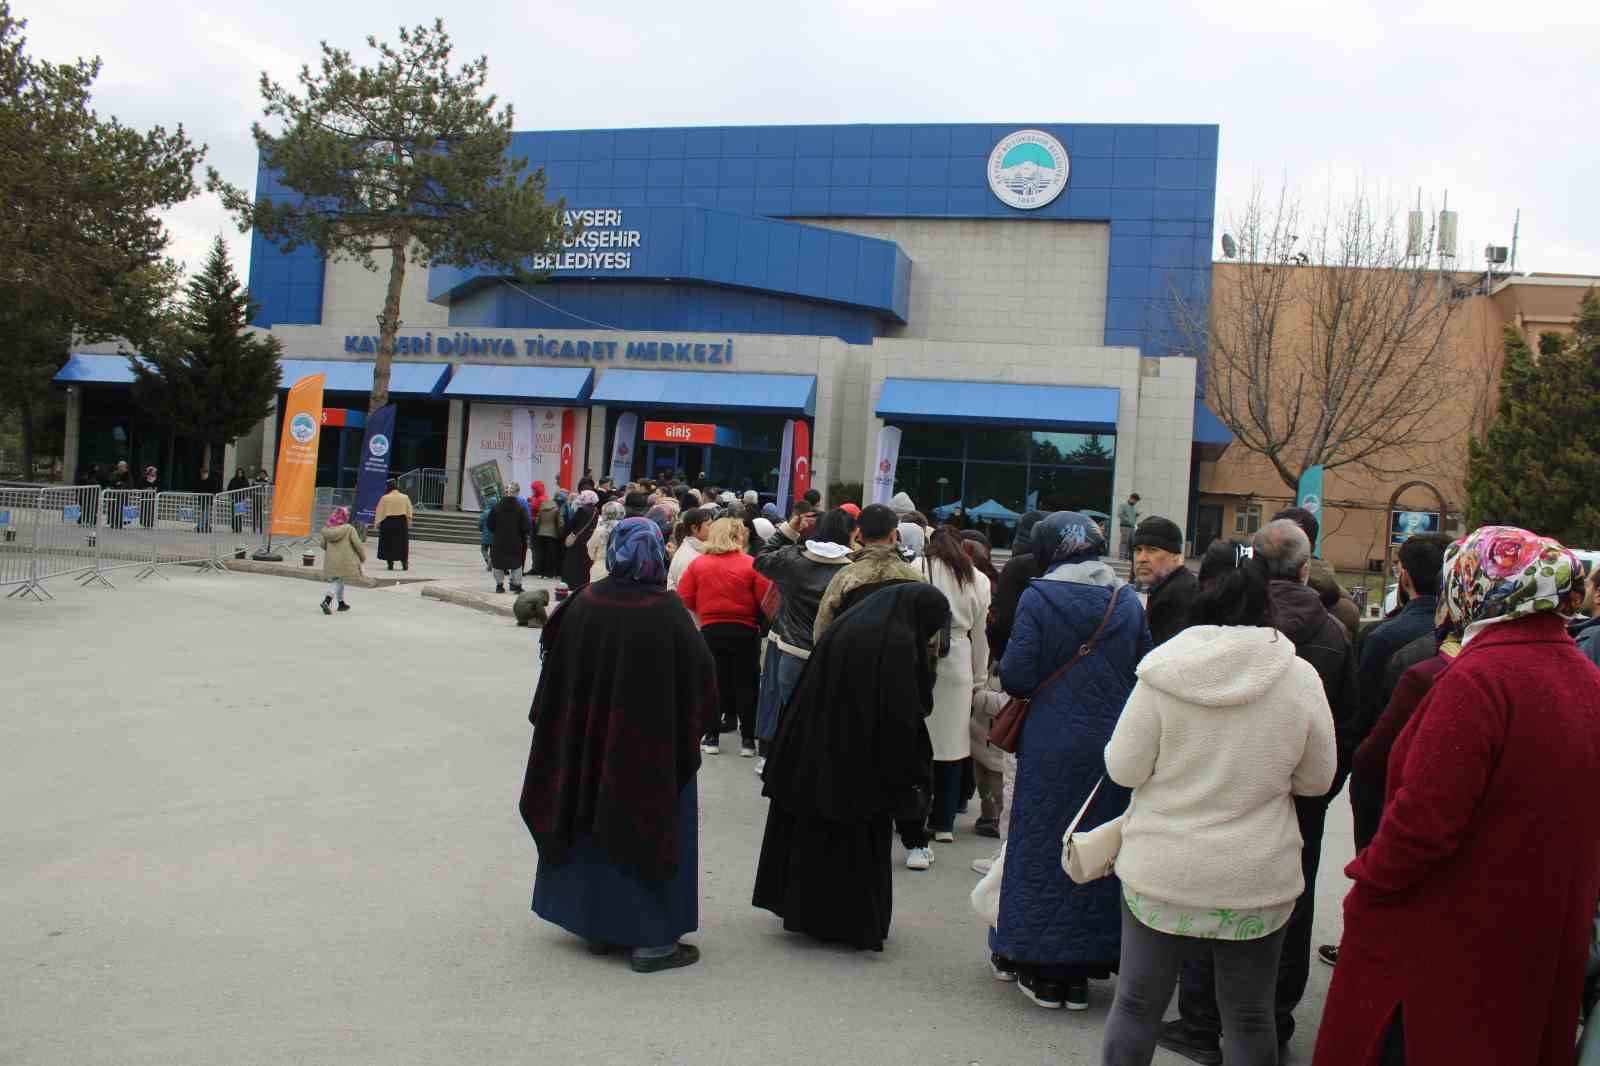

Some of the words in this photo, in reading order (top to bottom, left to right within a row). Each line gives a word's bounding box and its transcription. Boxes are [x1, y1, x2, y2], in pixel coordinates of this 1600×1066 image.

[533, 252, 631, 270] BELEDİYESİ
[436, 332, 517, 357] DÜNYA
[523, 333, 618, 361] TİCARET
[625, 338, 733, 364] MERKEZİ
[665, 425, 692, 441] GİRİŞ
